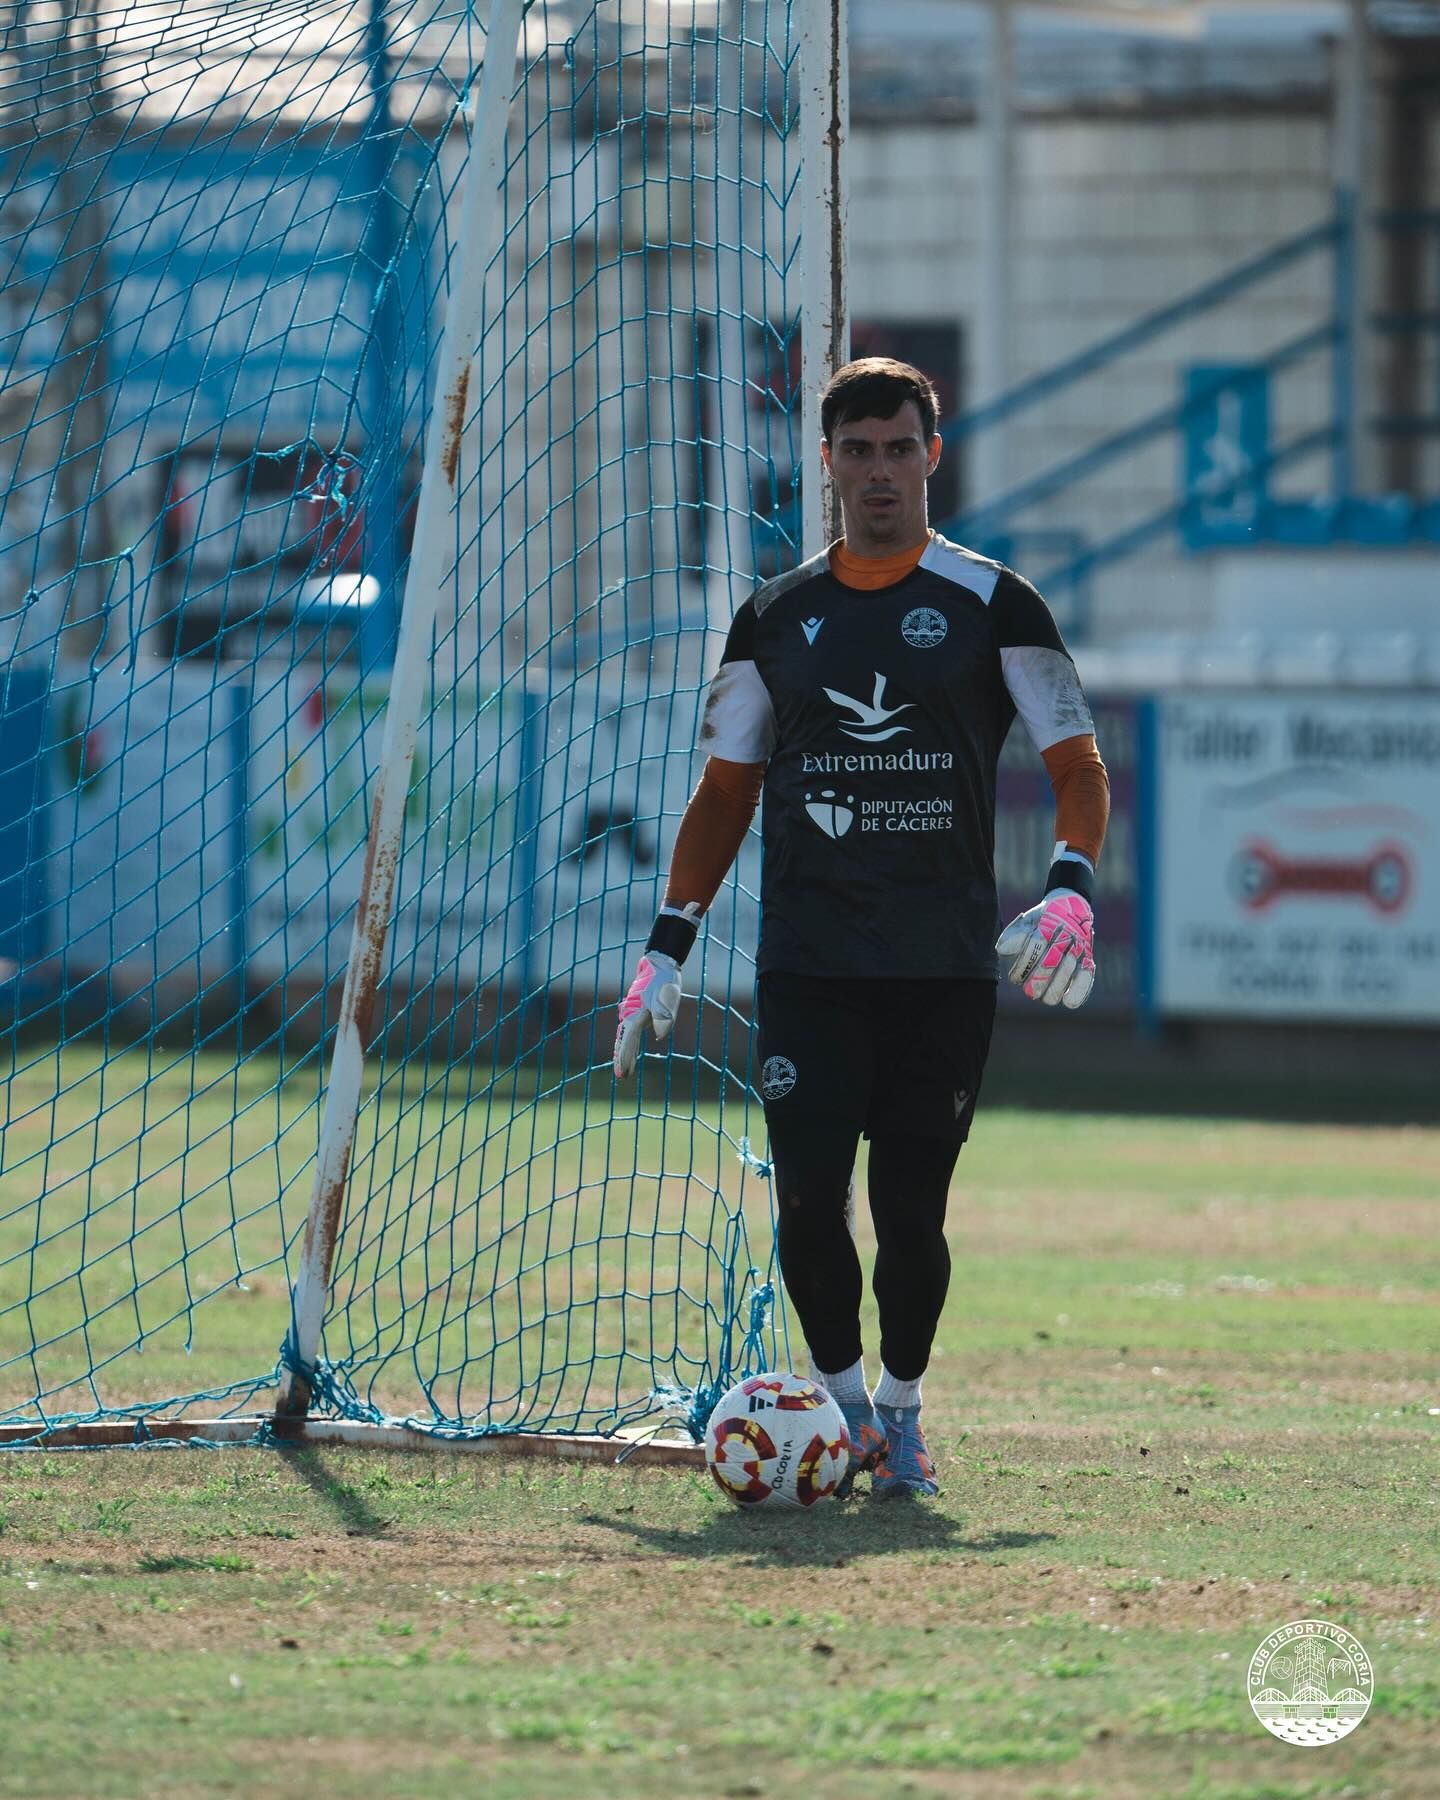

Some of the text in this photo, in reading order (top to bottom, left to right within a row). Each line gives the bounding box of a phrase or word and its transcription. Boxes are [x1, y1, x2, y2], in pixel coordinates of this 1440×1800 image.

[801, 748, 953, 773] Extremadura
[861, 797, 953, 814] DIPUTACIÓN
[861, 813, 953, 831] DE CÁCERES
